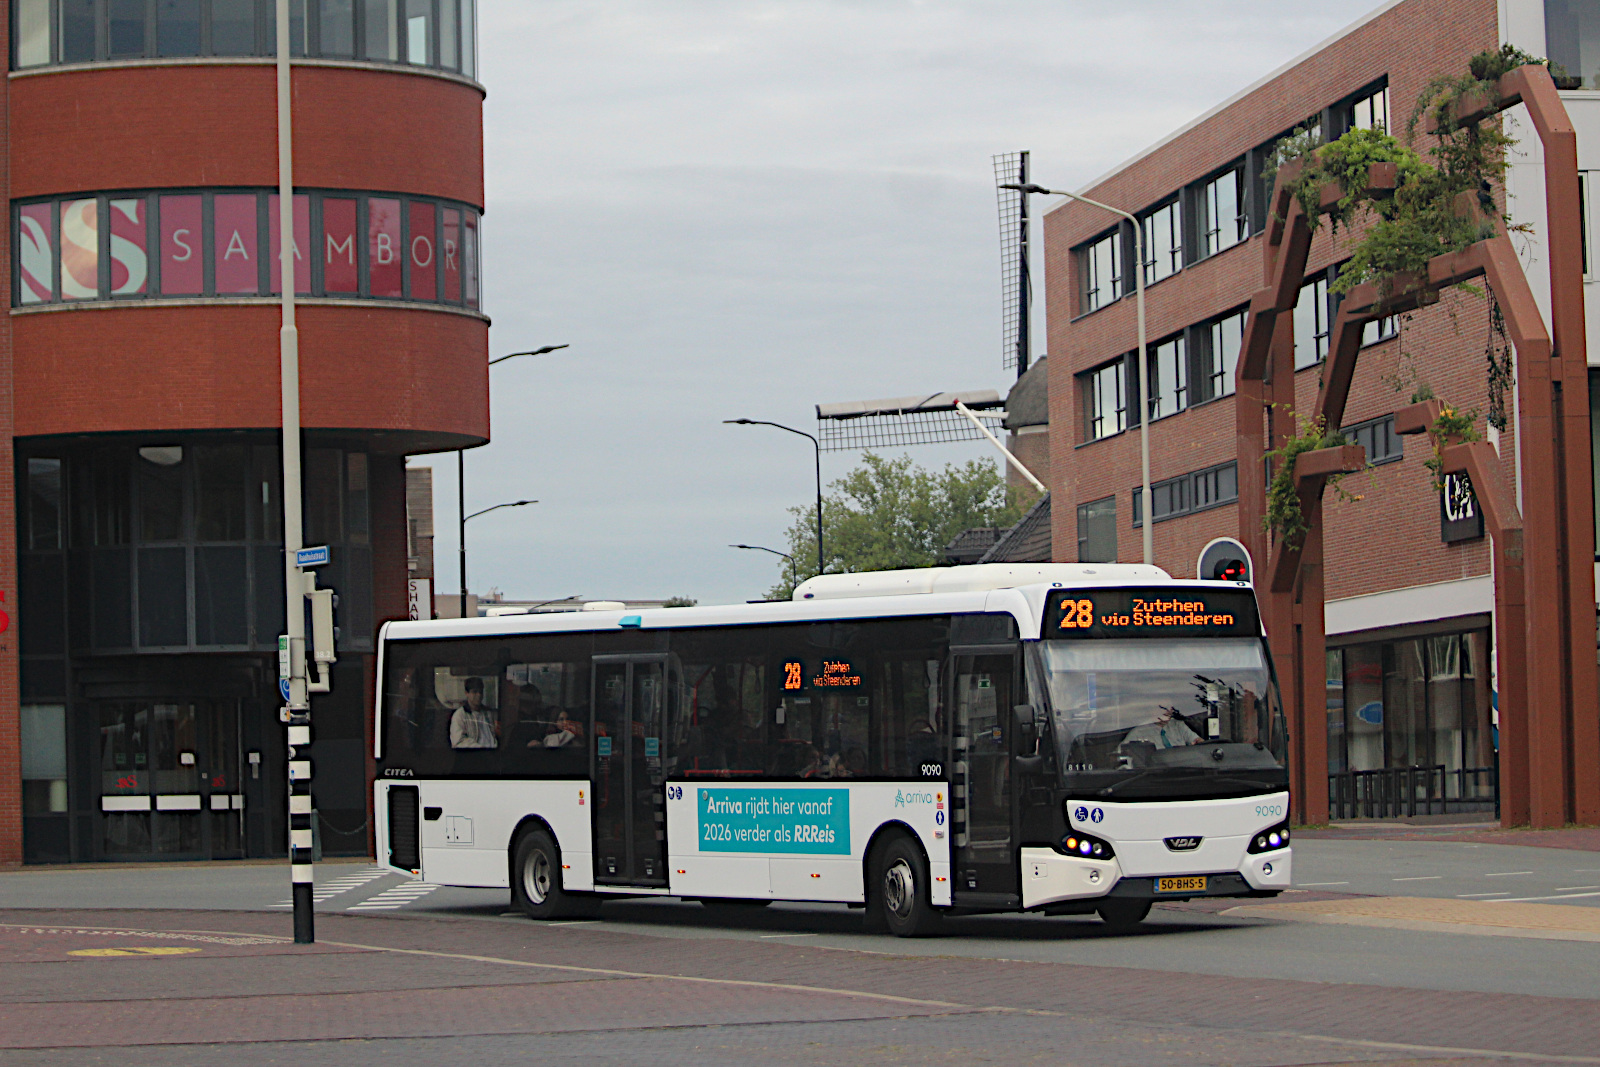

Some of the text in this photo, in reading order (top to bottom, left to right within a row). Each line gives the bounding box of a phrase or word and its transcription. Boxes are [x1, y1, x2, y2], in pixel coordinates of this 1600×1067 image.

[1060, 598, 1205, 628] 28 Zutphen
[1101, 612, 1234, 626] via Steenderen
[784, 660, 851, 689] 28 Zutphen
[823, 673, 861, 686] Steenderen
[384, 768, 414, 777] CITEA
[921, 764, 942, 776] 9090
[905, 790, 933, 804] arriva
[706, 796, 833, 819] Arriva rijdt hier vanaf
[1255, 805, 1282, 816] 9090
[703, 823, 835, 843] 2026 verder als RRReis
[1170, 838, 1197, 848] VDL
[1161, 878, 1204, 890] 50-BHS-5
